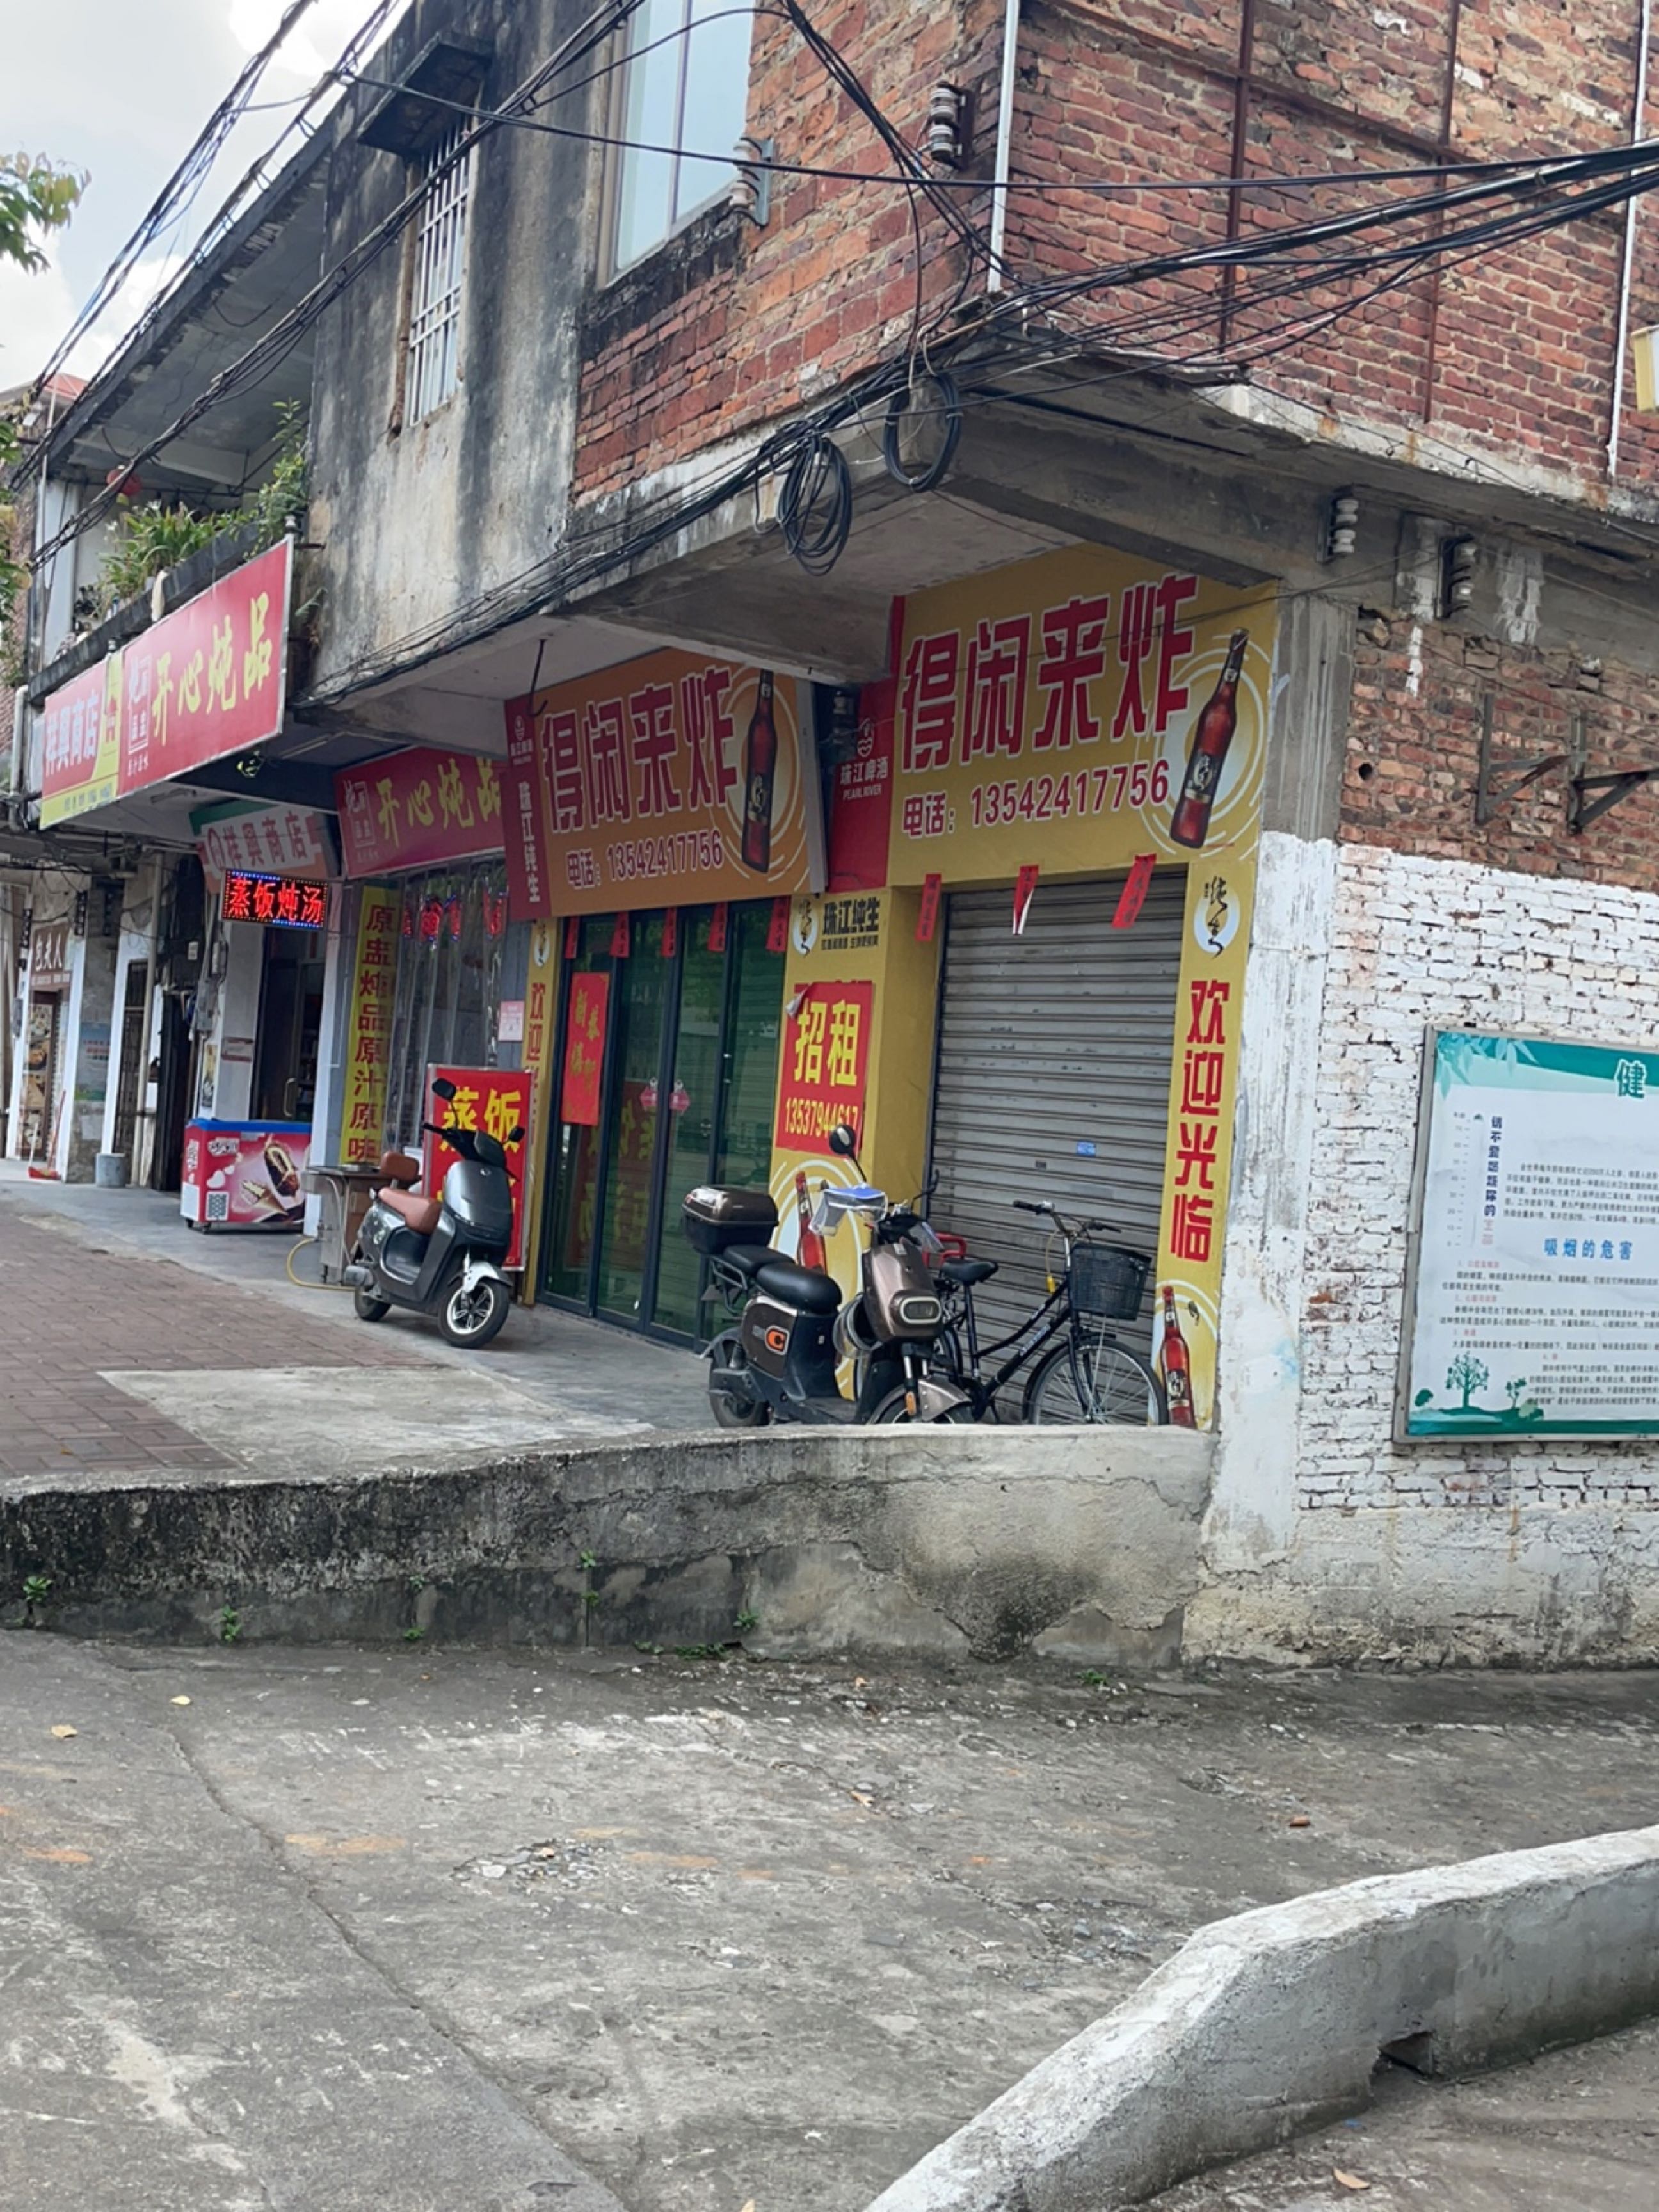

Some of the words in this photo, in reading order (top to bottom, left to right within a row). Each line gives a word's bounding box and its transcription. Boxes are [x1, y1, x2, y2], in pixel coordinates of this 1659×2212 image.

[152, 591, 273, 746] 开心炖品
[901, 575, 1198, 773] 得闲来炸
[541, 666, 738, 833] 得闲来炸
[228, 876, 323, 923] 蒸饭炖汤
[793, 998, 862, 1087] 招租
[1614, 1058, 1647, 1099] 健
[1170, 979, 1230, 1263] 欢迎光临
[1544, 1238, 1633, 1260] 吸烟的危害
